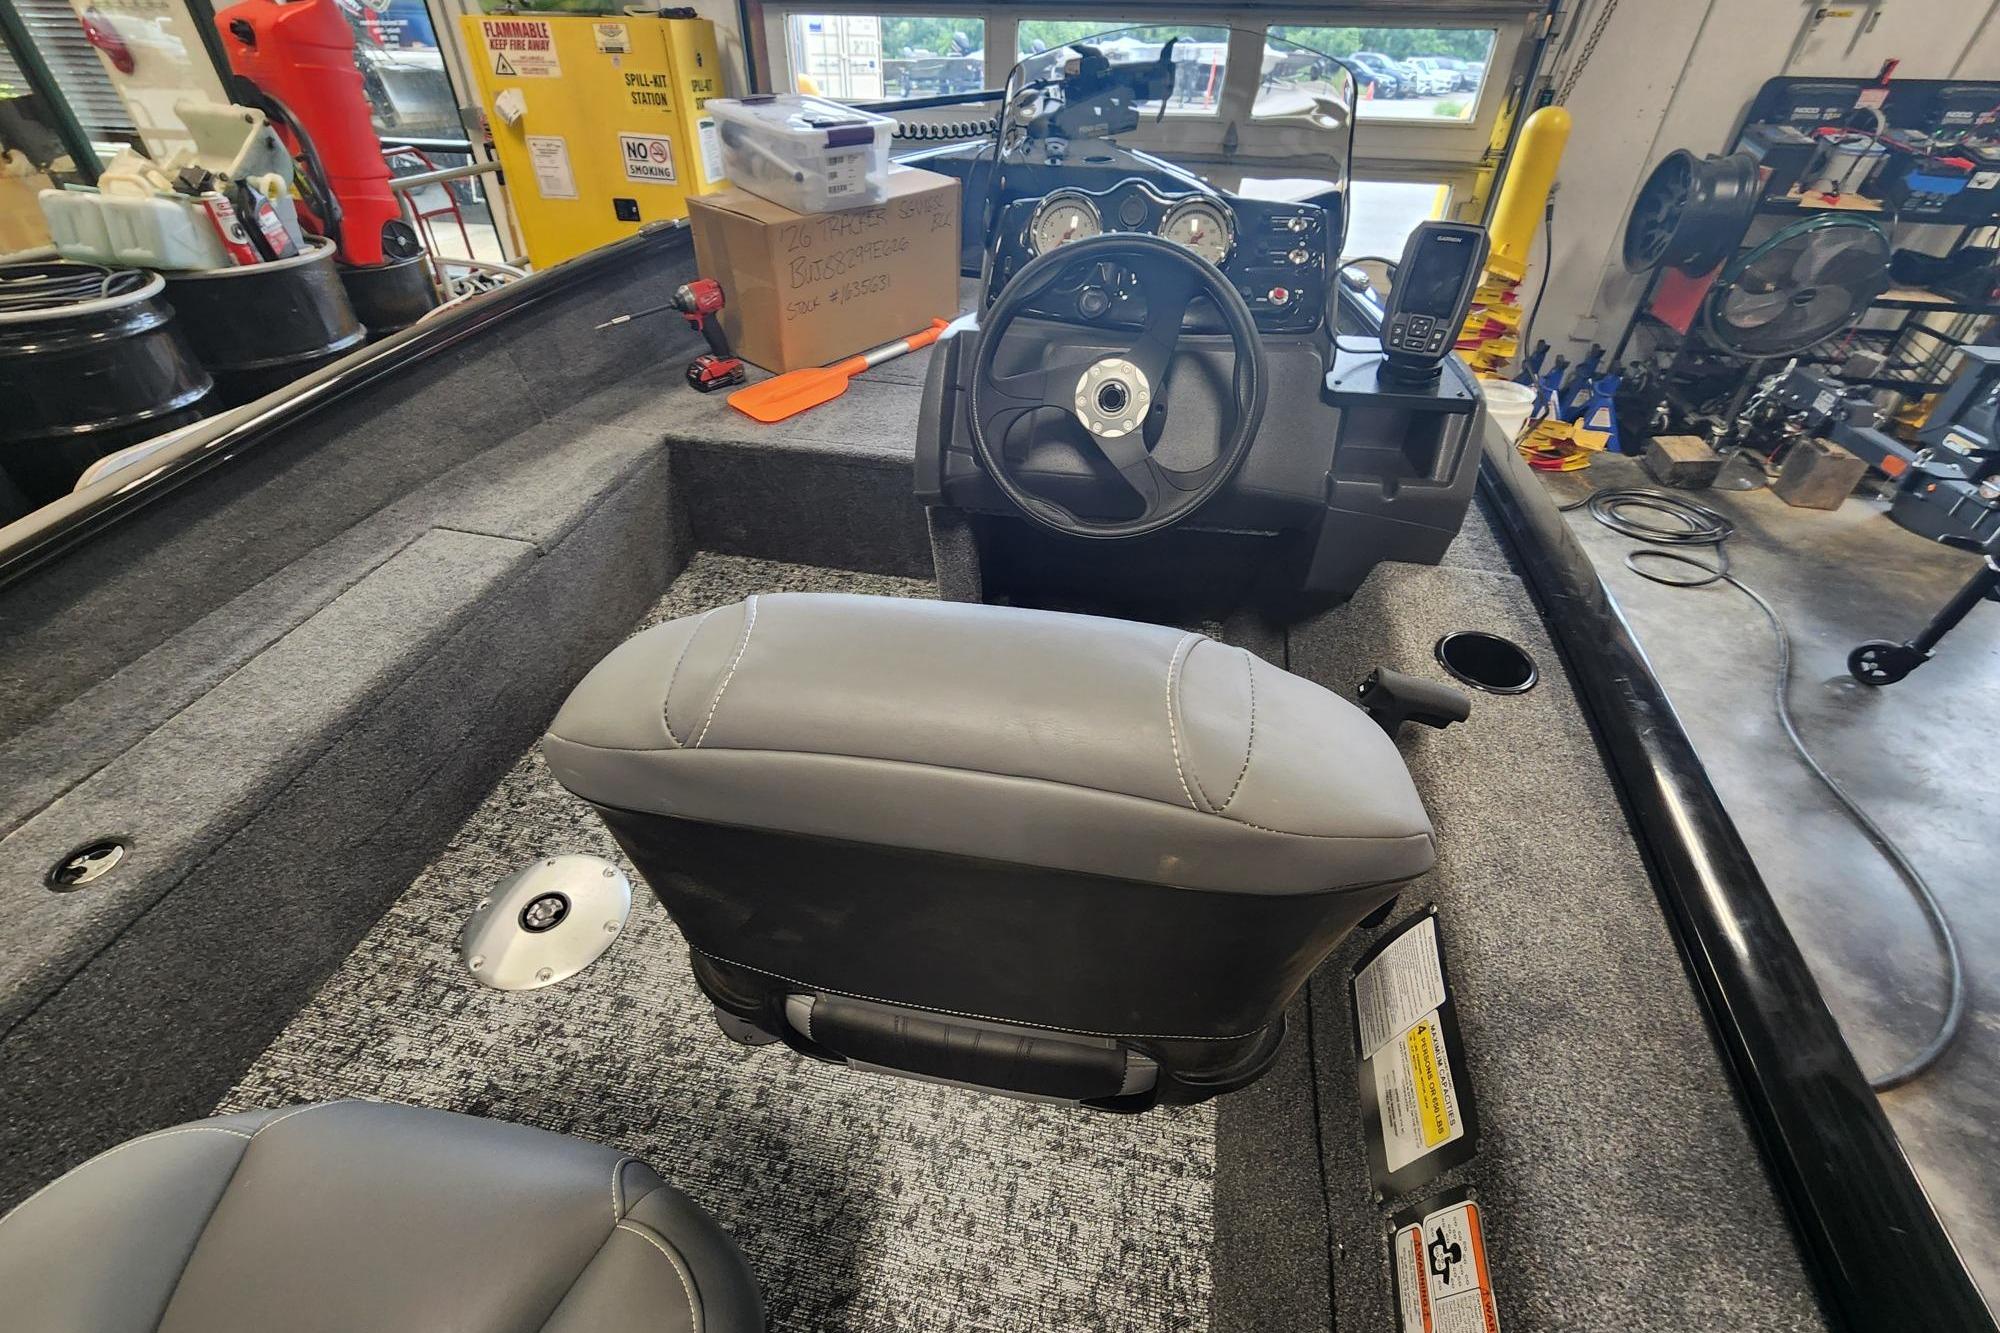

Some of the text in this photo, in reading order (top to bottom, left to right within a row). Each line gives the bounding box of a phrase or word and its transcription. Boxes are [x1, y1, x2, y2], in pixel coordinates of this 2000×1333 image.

[484, 22, 549, 38] FLAMMABLE
[490, 39, 550, 51] KEEP FIRE AWAY
[625, 73, 667, 88] SPILL-KIT
[631, 91, 668, 106] STATION
[626, 141, 648, 159] NO
[630, 164, 671, 177] SMOKING
[1417, 1025, 1426, 1036] 4
[1420, 1036, 1432, 1081] PERSONS
[1430, 1023, 1455, 1126] MAXIMUM CAPACITIES
[1428, 1081, 1436, 1097] OR
[1435, 1114, 1444, 1134] LBS
[1417, 1252, 1428, 1310] WARNING
